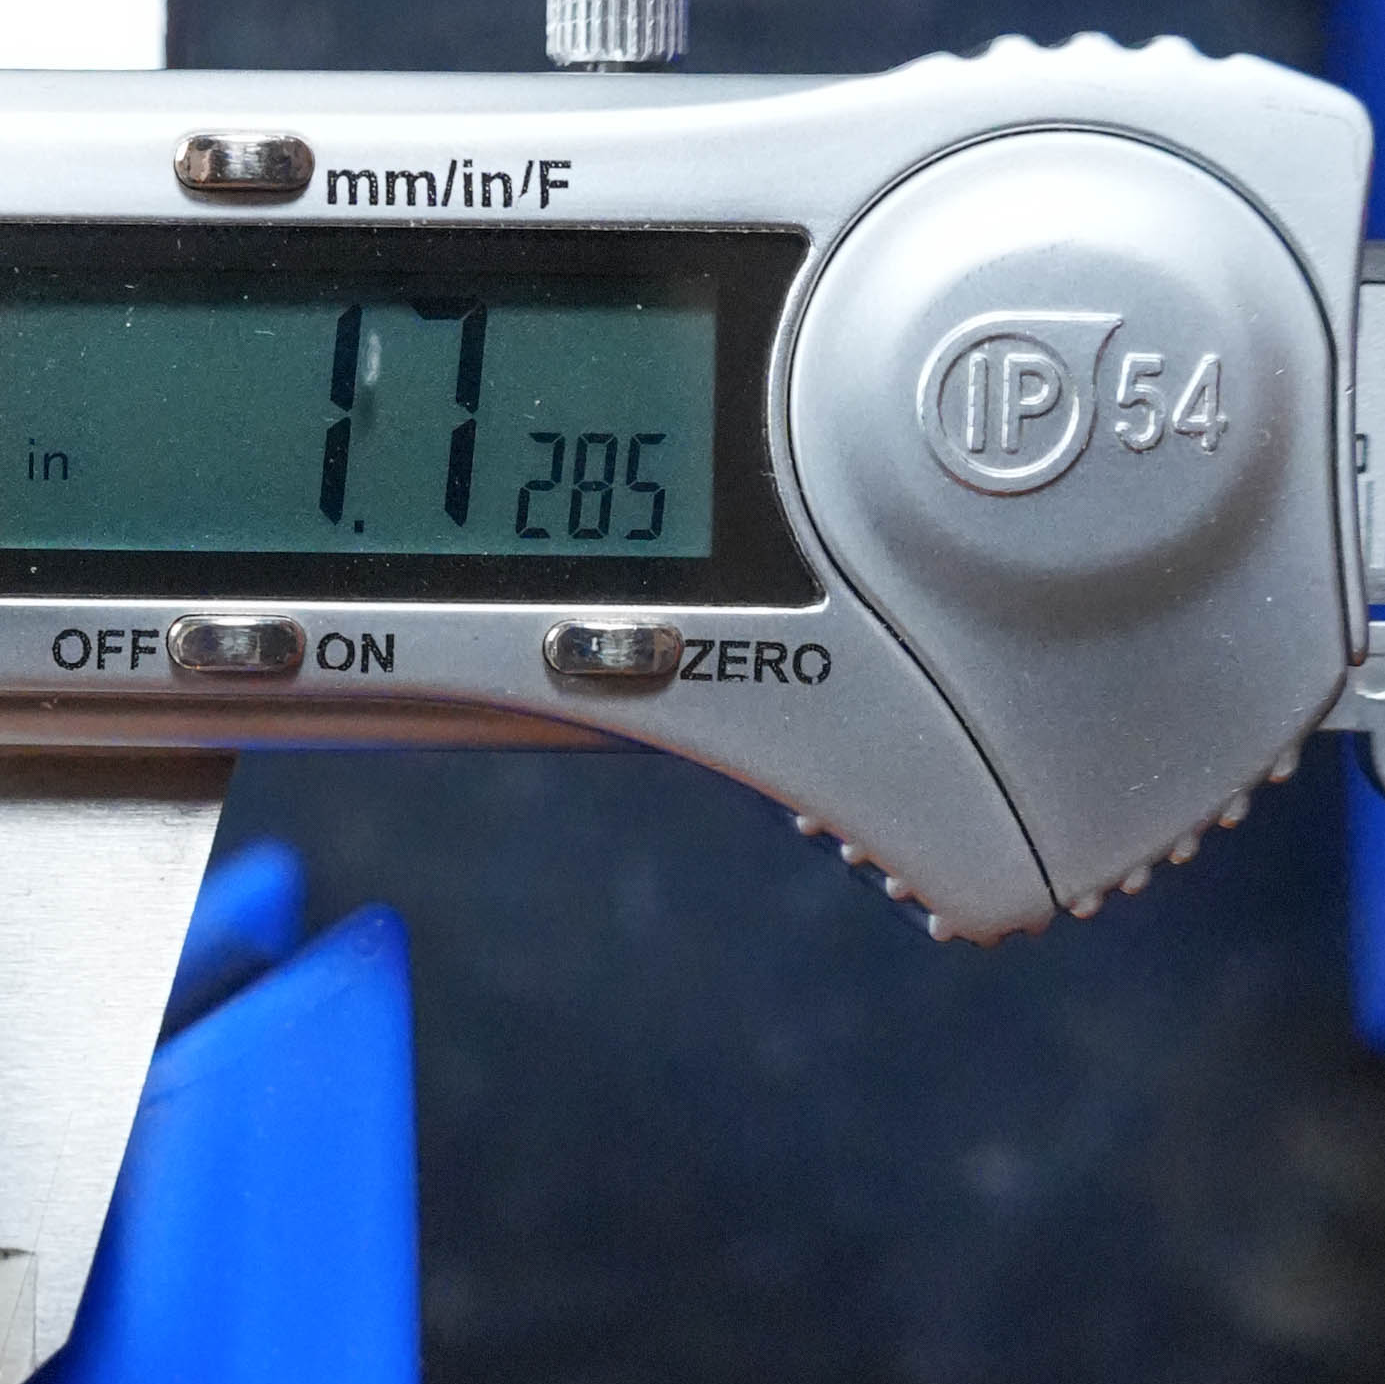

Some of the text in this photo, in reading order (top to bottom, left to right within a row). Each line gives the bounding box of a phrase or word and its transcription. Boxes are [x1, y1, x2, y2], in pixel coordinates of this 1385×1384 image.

[327, 159, 571, 210] mm/in/F
[966, 353, 1228, 454] IP 54
[28, 437, 69, 481] in
[51, 628, 395, 674] OFF ON
[681, 638, 832, 685] ZERO
